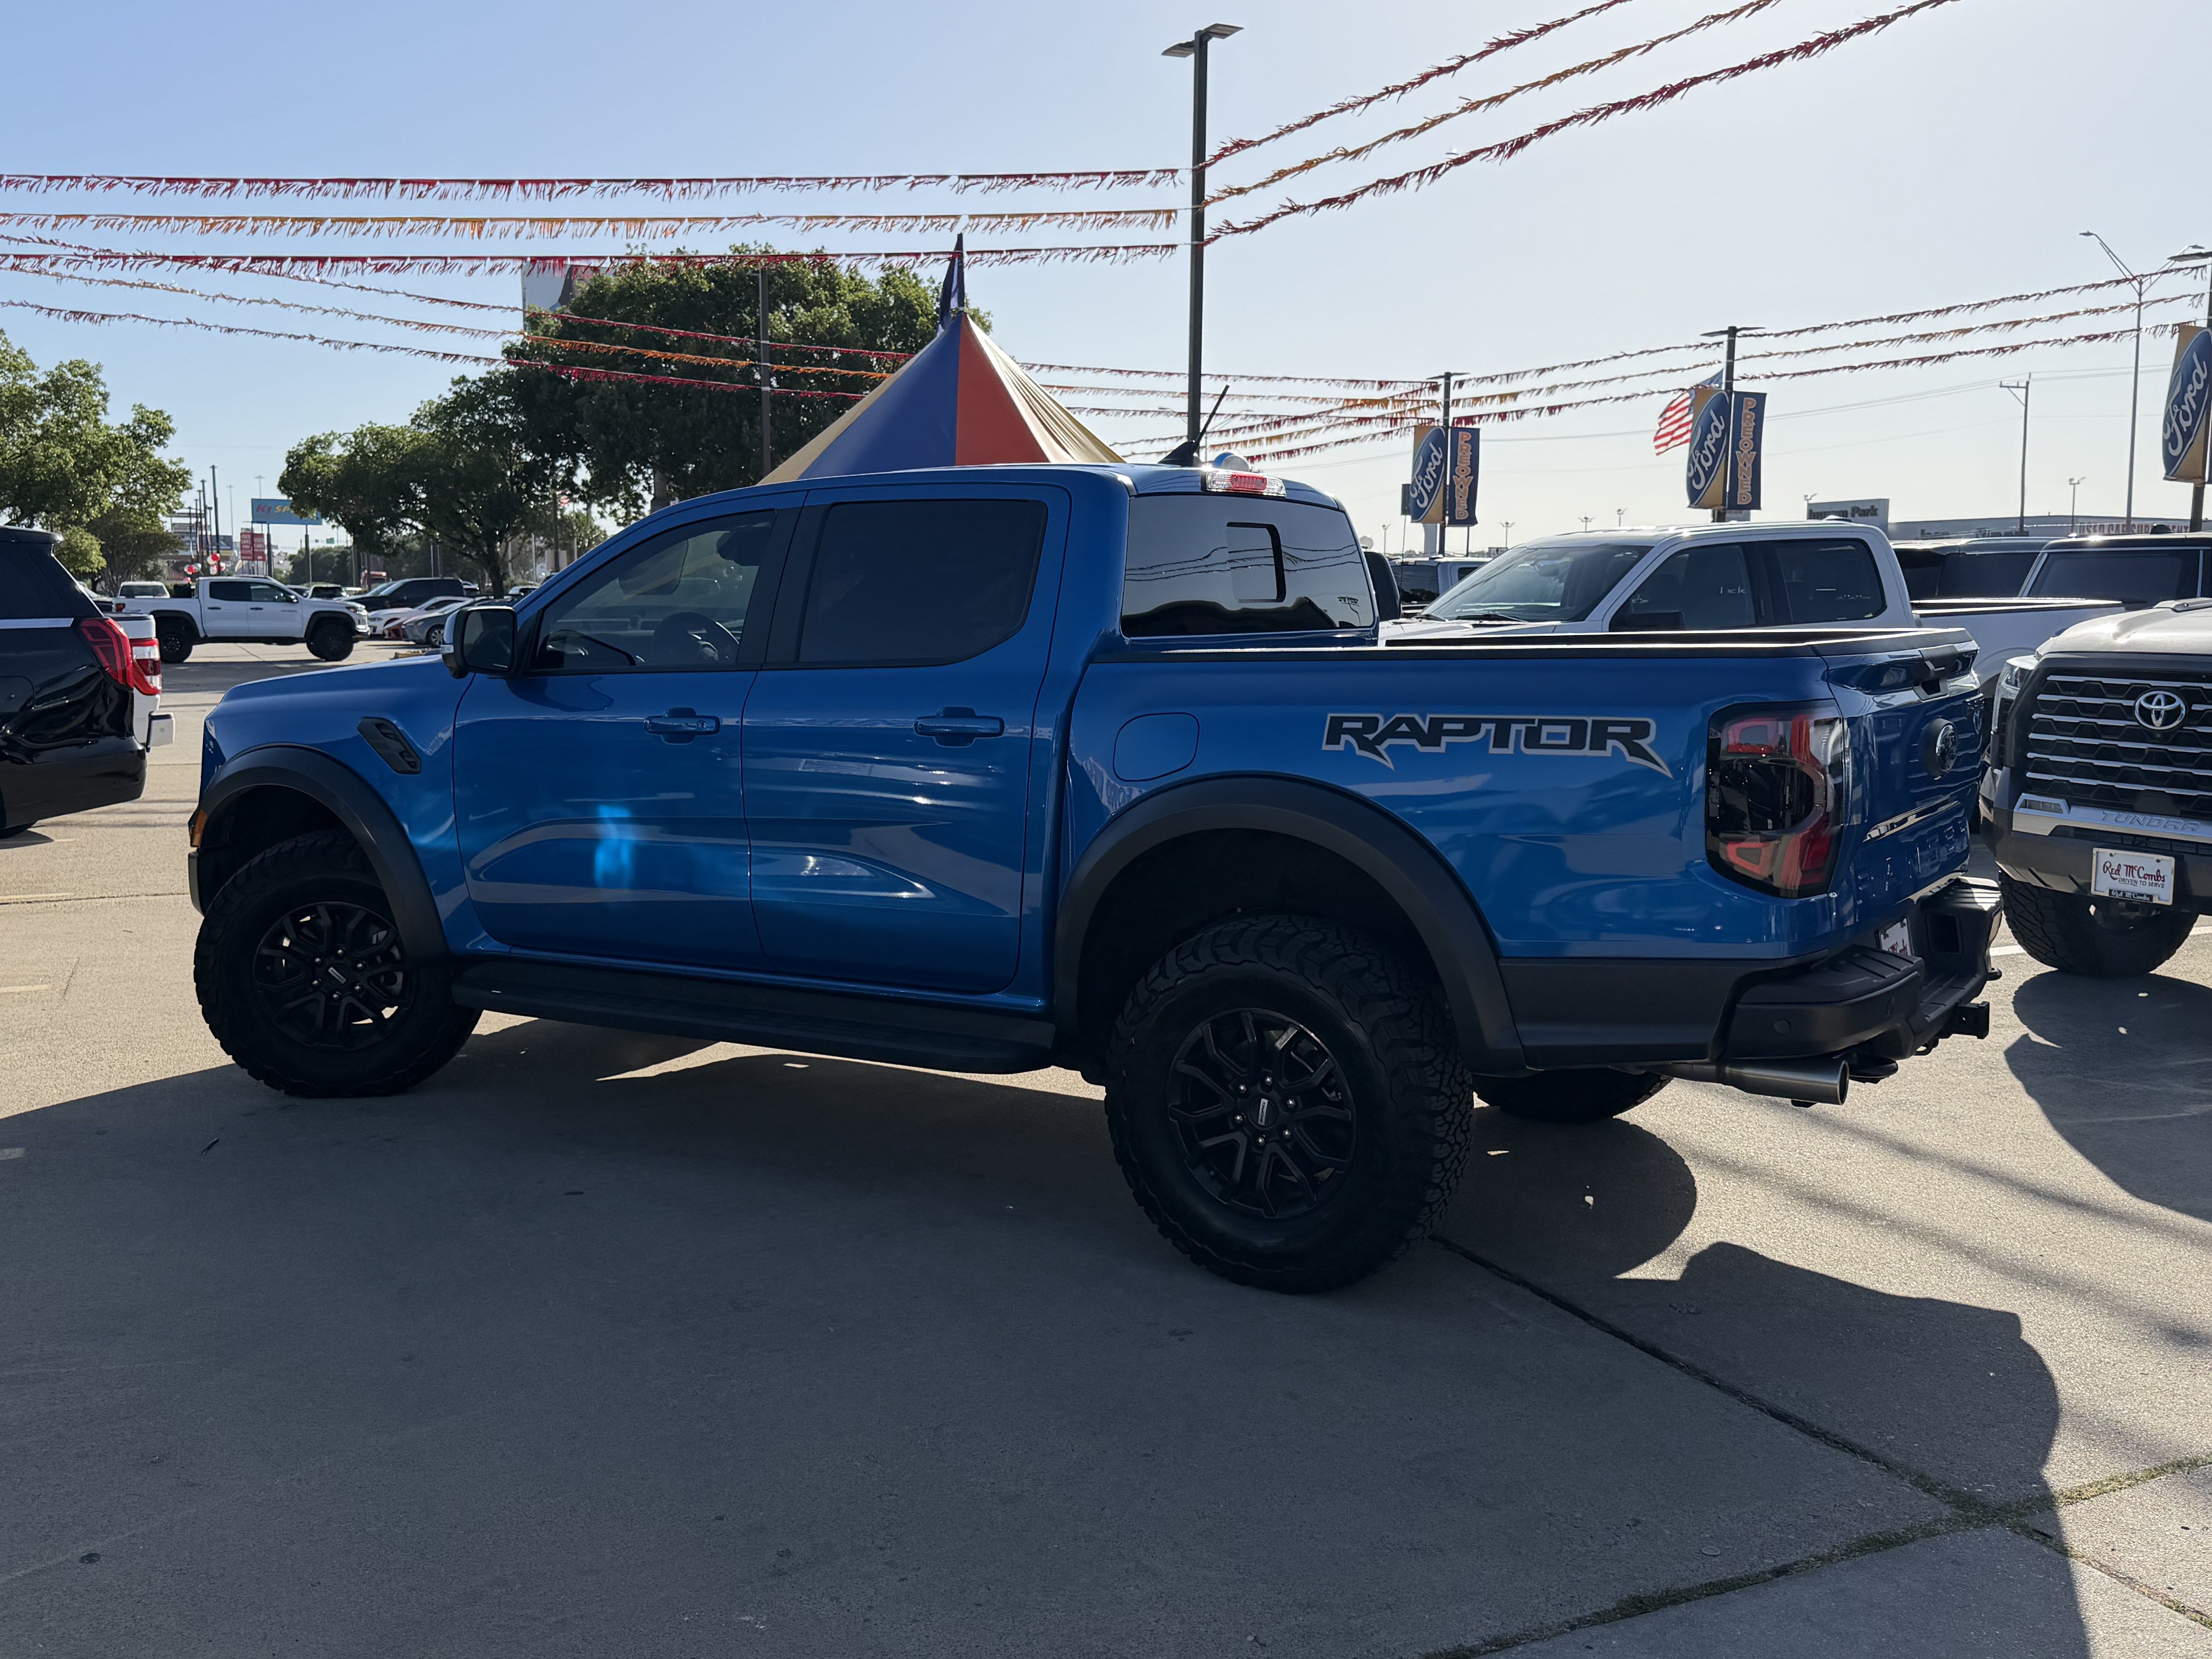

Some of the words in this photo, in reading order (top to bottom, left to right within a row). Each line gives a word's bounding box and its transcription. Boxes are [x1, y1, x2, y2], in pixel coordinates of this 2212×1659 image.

[2162, 352, 2207, 456] Ford
[1410, 442, 1443, 509] Ford
[1453, 431, 1474, 520] PREOWNED
[1687, 409, 1725, 490] Ford
[1736, 398, 1757, 505] PREOWNED
[1851, 505, 1878, 517] Park
[2079, 522, 2104, 534] USED
[1322, 713, 1673, 779] RAPTOR
[2102, 811, 2201, 831] TUNDRA
[2103, 861, 2121, 881] Red
